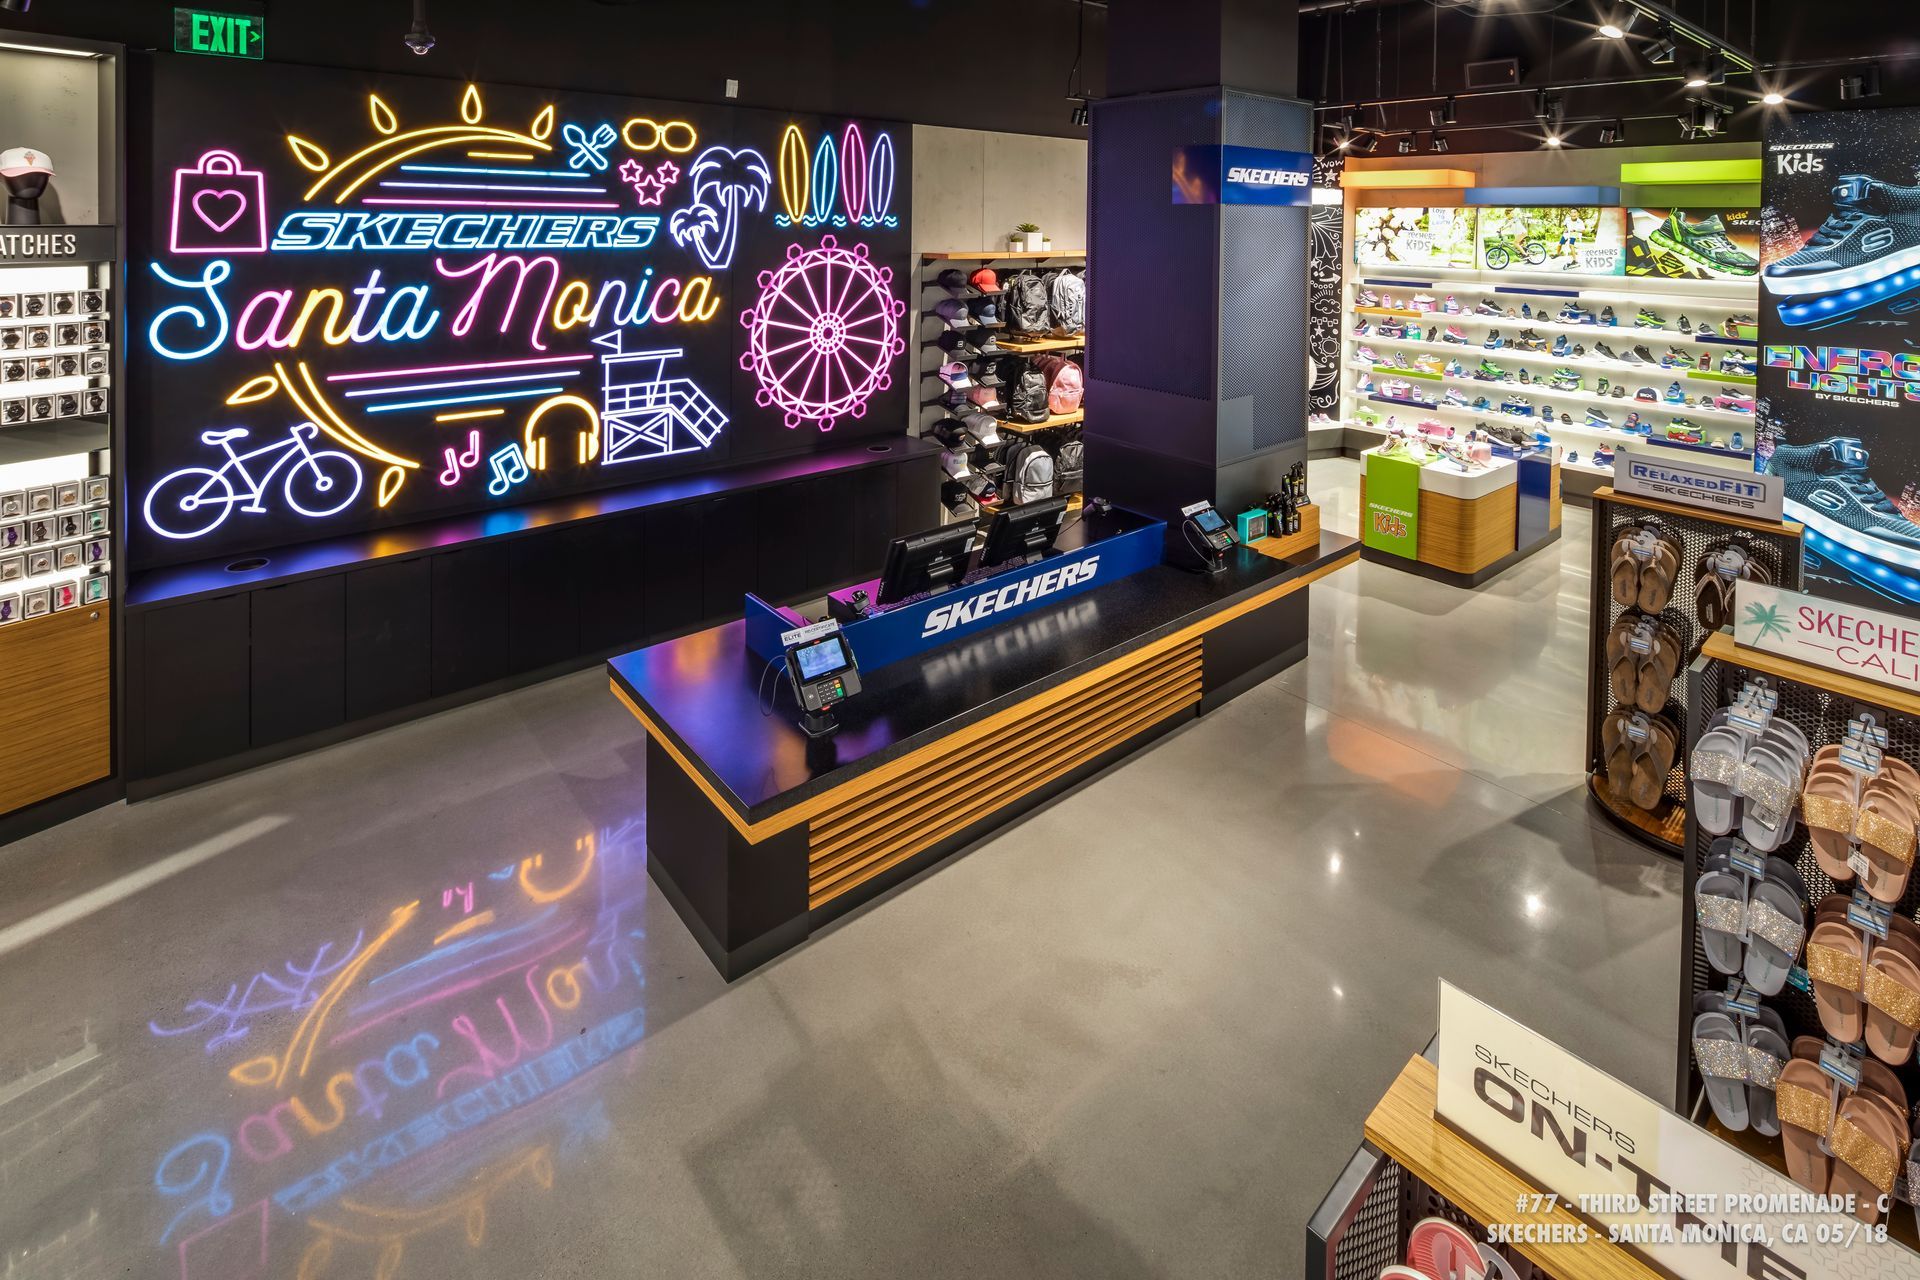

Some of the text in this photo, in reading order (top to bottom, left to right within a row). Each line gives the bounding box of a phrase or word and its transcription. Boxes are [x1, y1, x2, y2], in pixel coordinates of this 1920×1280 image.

[192, 13, 251, 55] EXIT
[1769, 143, 1835, 152] SKECHERS
[1227, 167, 1310, 187] SKECHERS
[1321, 160, 1344, 169] WOW
[1777, 153, 1825, 175] Kids
[270, 211, 661, 251] SKECHERS
[148, 252, 721, 361] Santa Monica
[1787, 370, 1920, 402] LIGHTS
[1833, 395, 1900, 408] SKECHERS
[1368, 502, 1414, 518] SKECHERS
[1651, 484, 1755, 510] SKECHERS
[1374, 512, 1408, 538] Kids
[921, 555, 1101, 639] SKECHERS
[1473, 1043, 1637, 1155] SKECHERS
